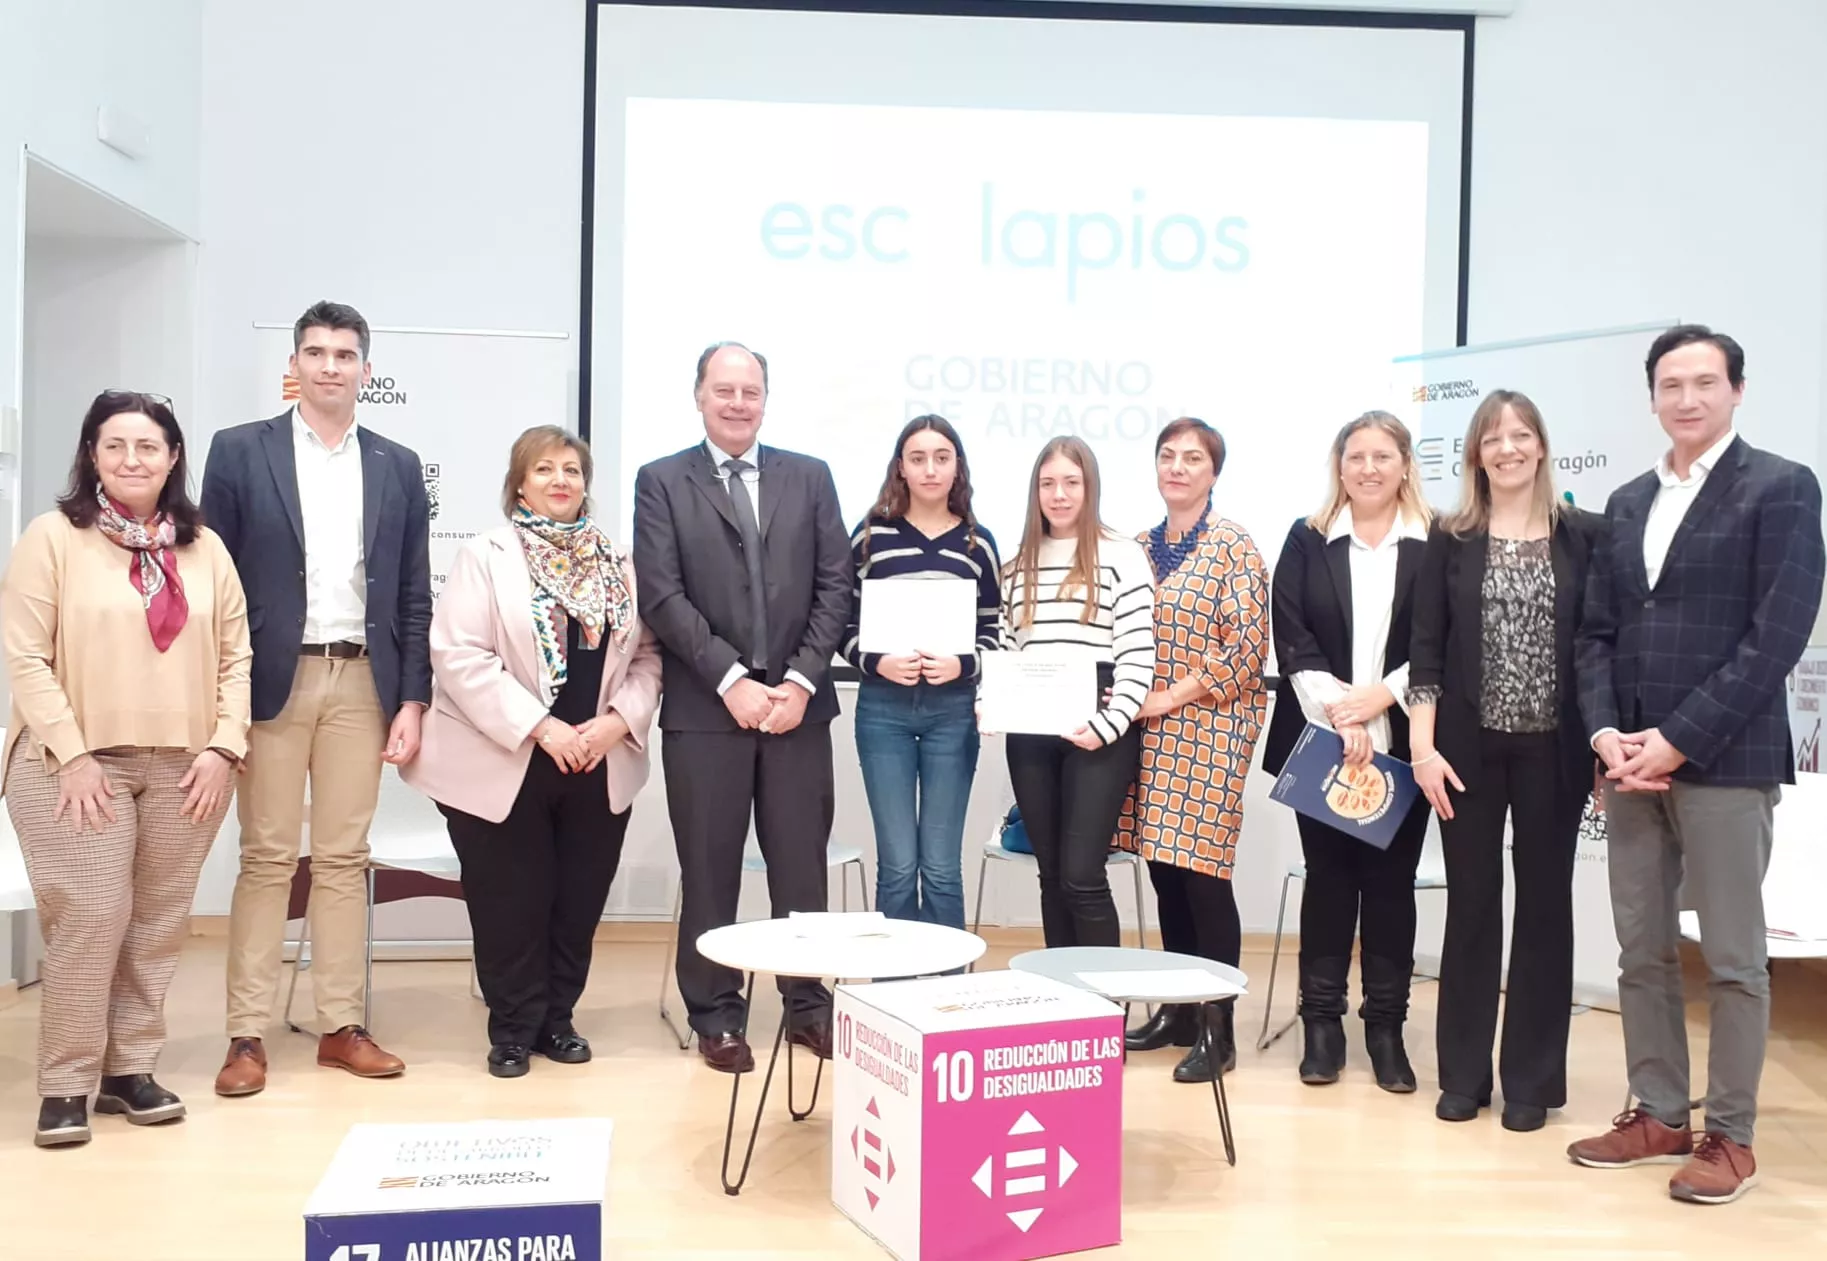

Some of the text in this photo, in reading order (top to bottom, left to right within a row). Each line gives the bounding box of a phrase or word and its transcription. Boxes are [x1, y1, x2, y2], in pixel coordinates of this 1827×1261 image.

[760, 181, 1251, 304] esc lapios
[904, 355, 1154, 398] GOBIERNO
[1427, 379, 1473, 393] GOBIERNO
[1441, 387, 1480, 401] ARAGON
[837, 1008, 852, 1060] 10
[983, 1036, 1121, 1072] REDUCCIÓN DE LAS
[932, 1050, 975, 1103] 10
[983, 1065, 1103, 1100] DESIGUALDADES
[419, 1176, 550, 1188] DE ARAGON
[422, 1171, 536, 1181] GOBIERNO
[517, 1234, 577, 1261] PARA
